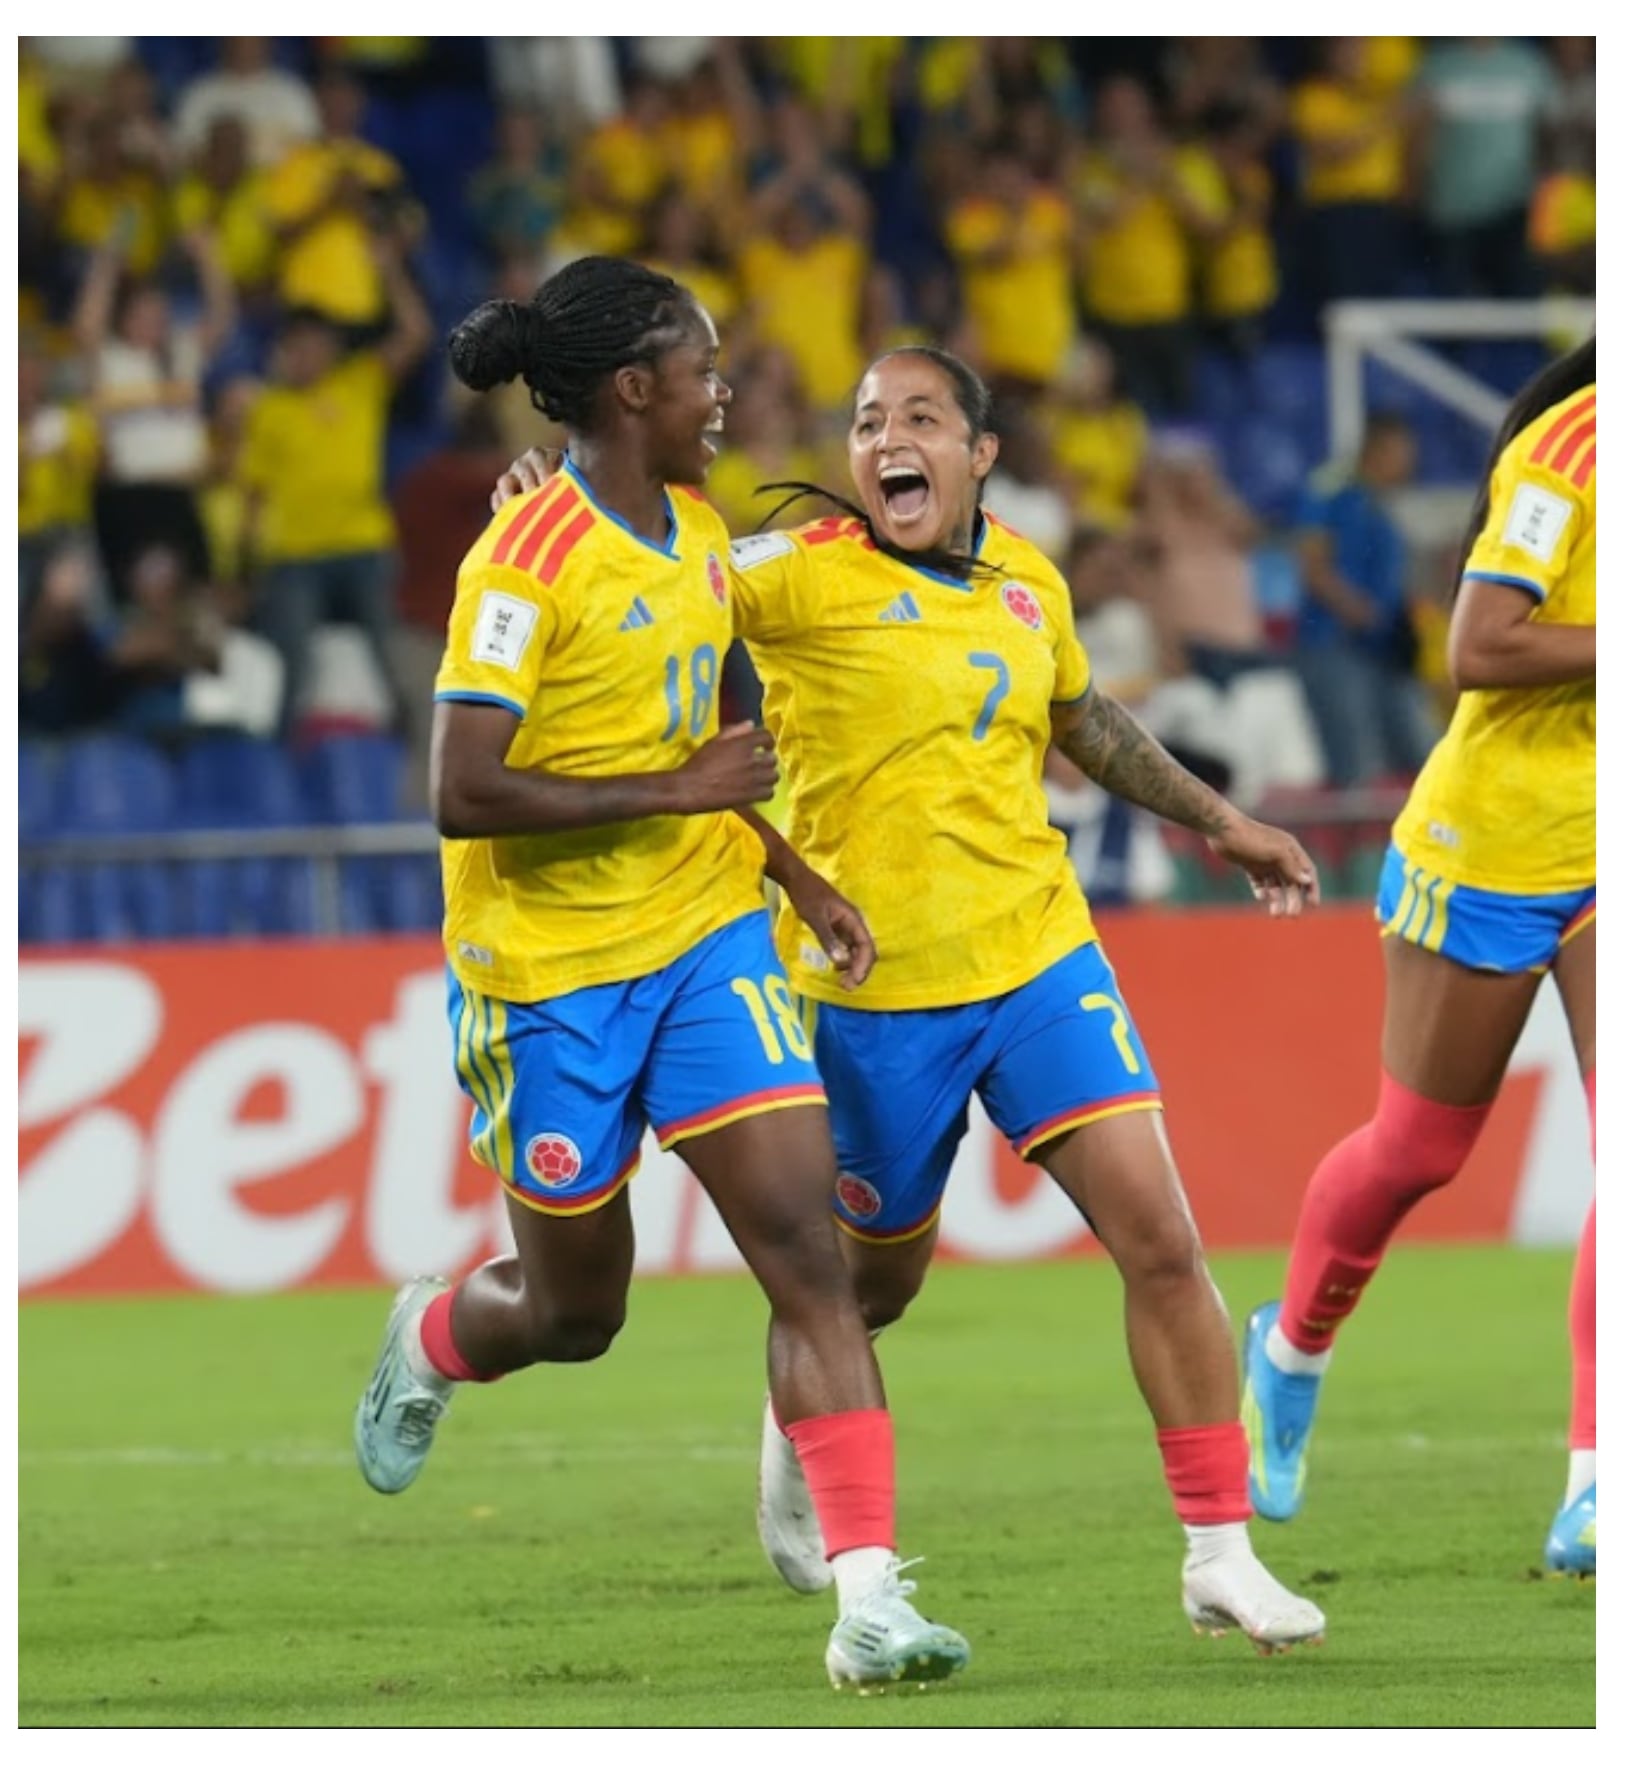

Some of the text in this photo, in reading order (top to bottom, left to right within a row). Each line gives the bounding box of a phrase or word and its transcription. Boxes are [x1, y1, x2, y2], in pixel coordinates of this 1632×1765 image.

[659, 643, 716, 742] 18
[968, 651, 1010, 741] 7
[730, 973, 814, 1065] 18
[1078, 992, 1141, 1075] 7
